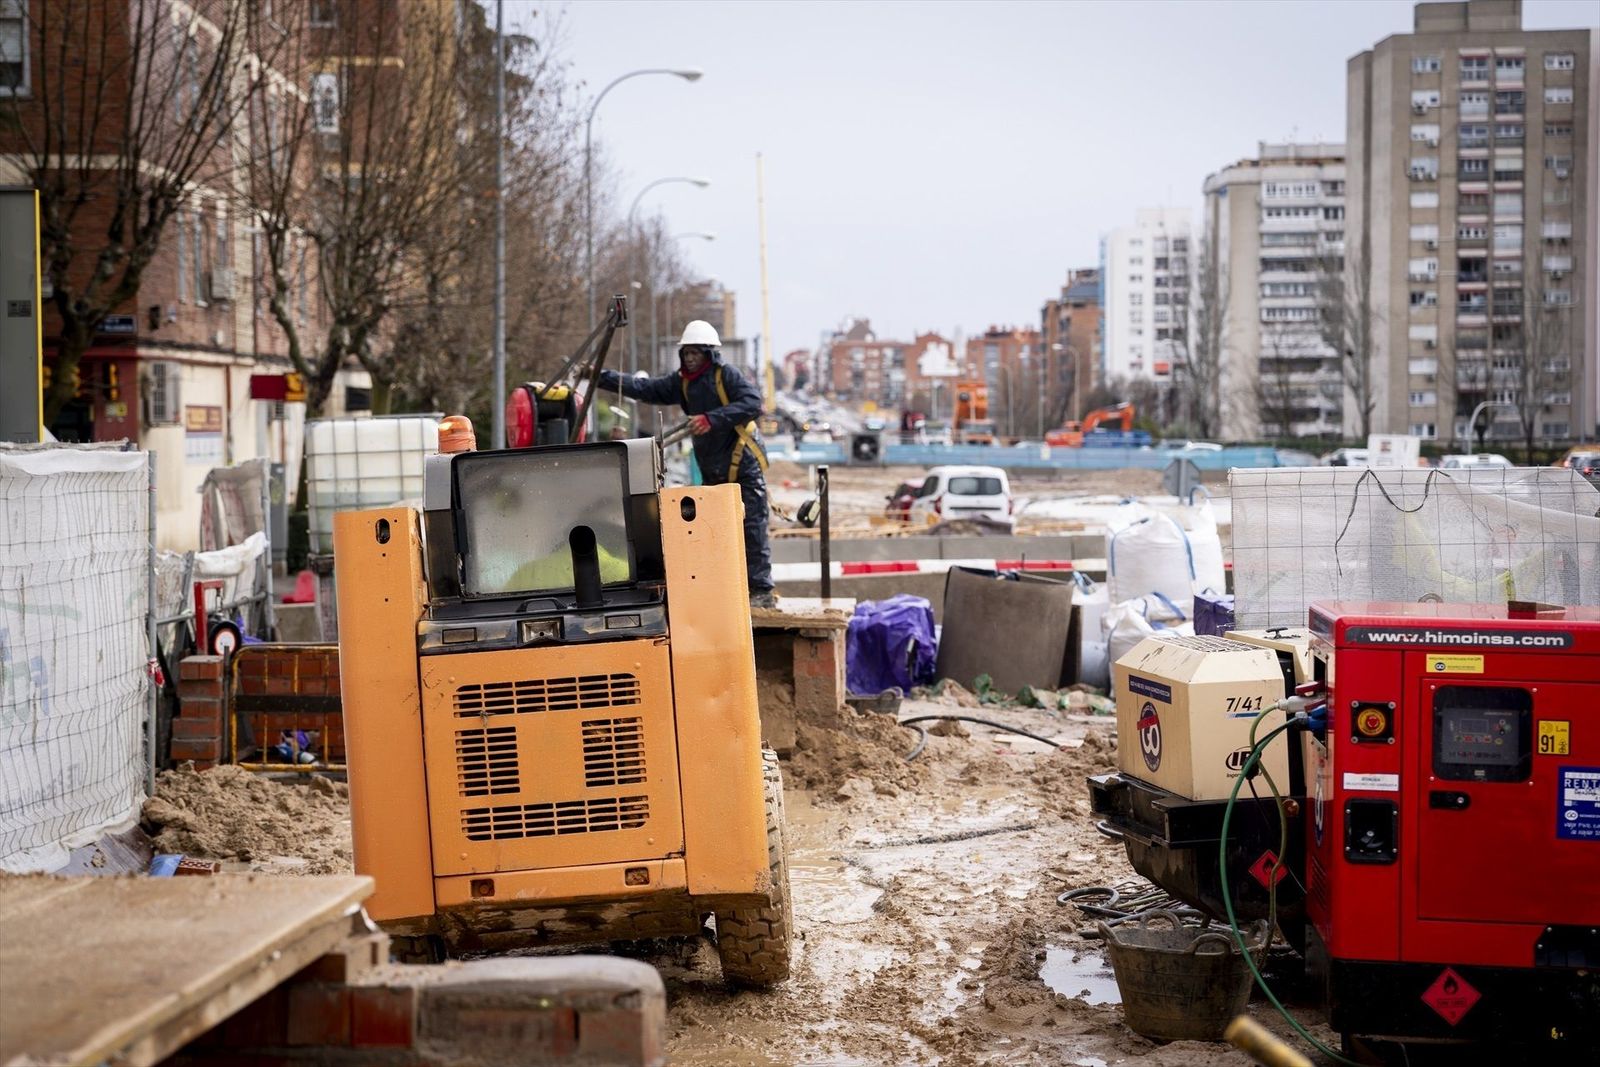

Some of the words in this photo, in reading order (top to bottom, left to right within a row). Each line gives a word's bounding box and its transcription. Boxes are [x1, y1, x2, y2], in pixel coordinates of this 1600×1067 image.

[1367, 631, 1565, 647] www.himoinsa.com
[1226, 696, 1263, 713] 7/41
[1541, 734, 1555, 753] 91
[1564, 778, 1600, 789] RENT
